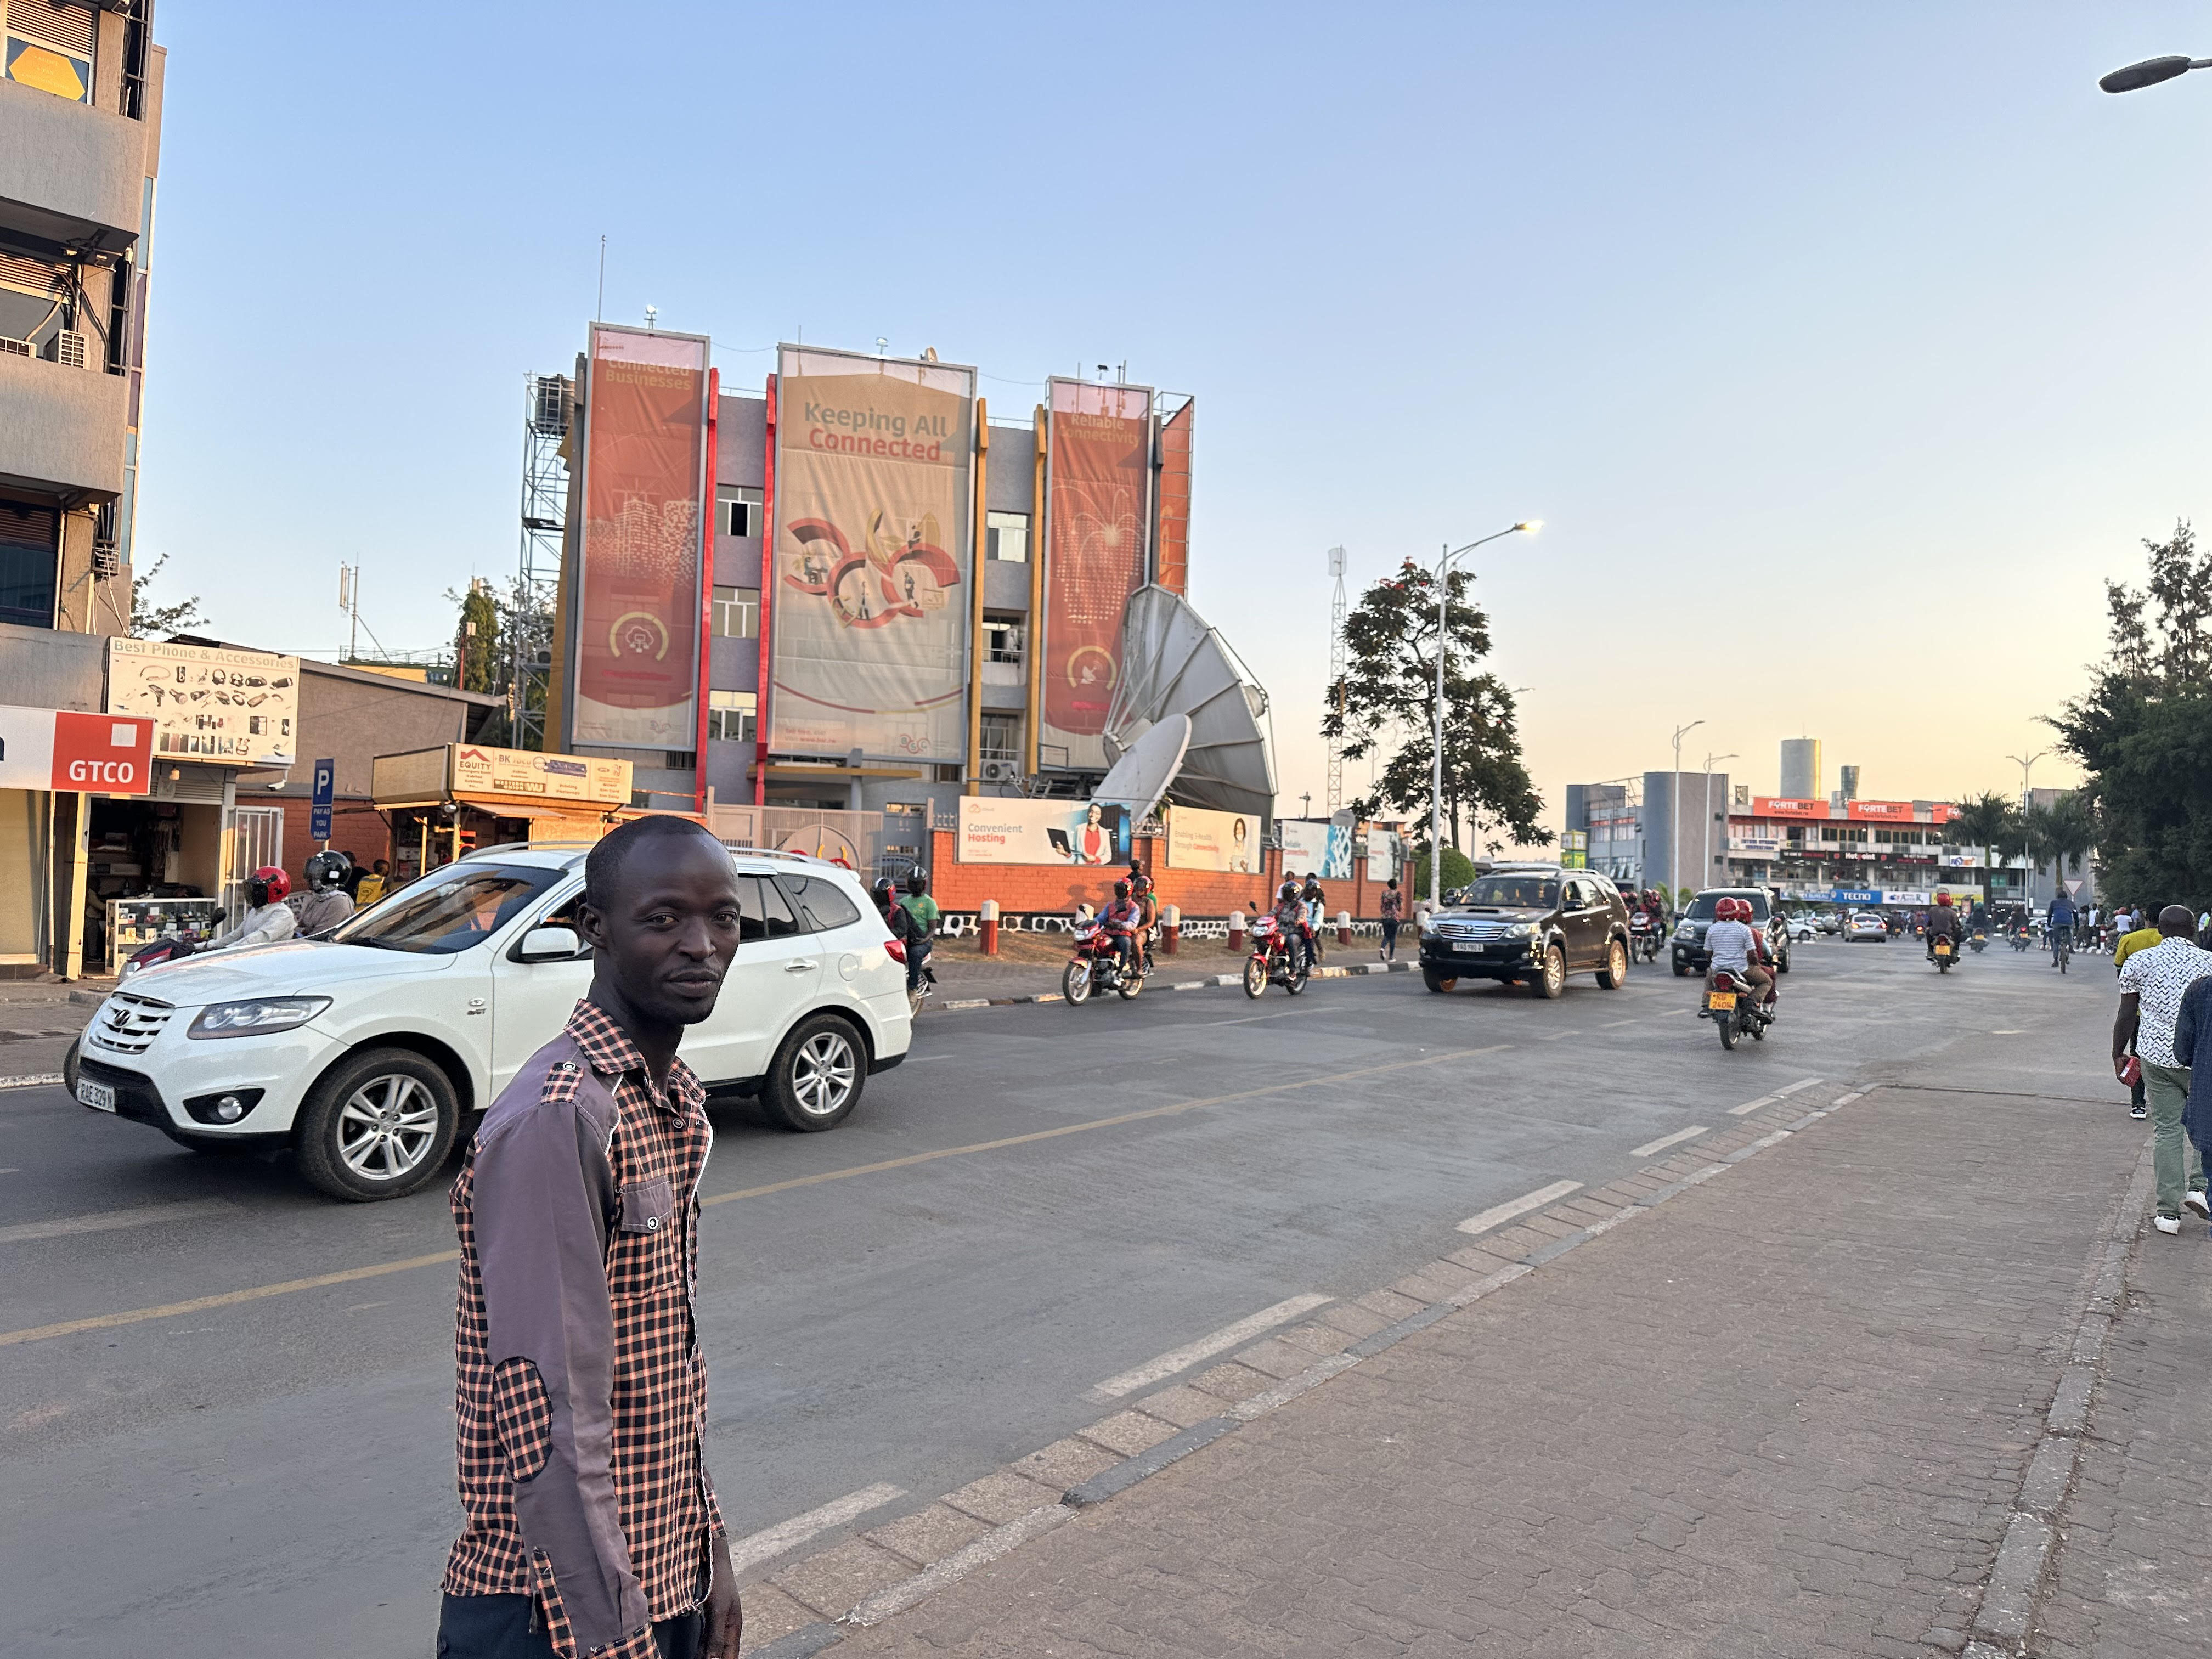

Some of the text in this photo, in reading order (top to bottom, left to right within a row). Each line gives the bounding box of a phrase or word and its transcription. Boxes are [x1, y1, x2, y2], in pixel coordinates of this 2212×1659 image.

[606, 369, 691, 390] Businesses
[804, 402, 947, 438] Keeping All
[1071, 414, 1125, 431] Reliable
[1059, 426, 1141, 448] Connectivity
[809, 428, 941, 461] Connected
[114, 640, 295, 669] Best Phone & Accessories
[499, 754, 510, 763] BK
[460, 761, 492, 770] EQUITY
[69, 760, 134, 783] GTCO
[317, 769, 329, 795] P
[526, 783, 543, 792] WU
[1768, 800, 1815, 810] FORTEBET
[1858, 804, 1904, 814] FORTEBET
[968, 823, 1023, 833] Convenient
[313, 831, 328, 839] PARK
[968, 833, 1006, 845] Hosting
[1845, 852, 1875, 862] Hotpoint
[1843, 891, 1871, 901] TECNO
